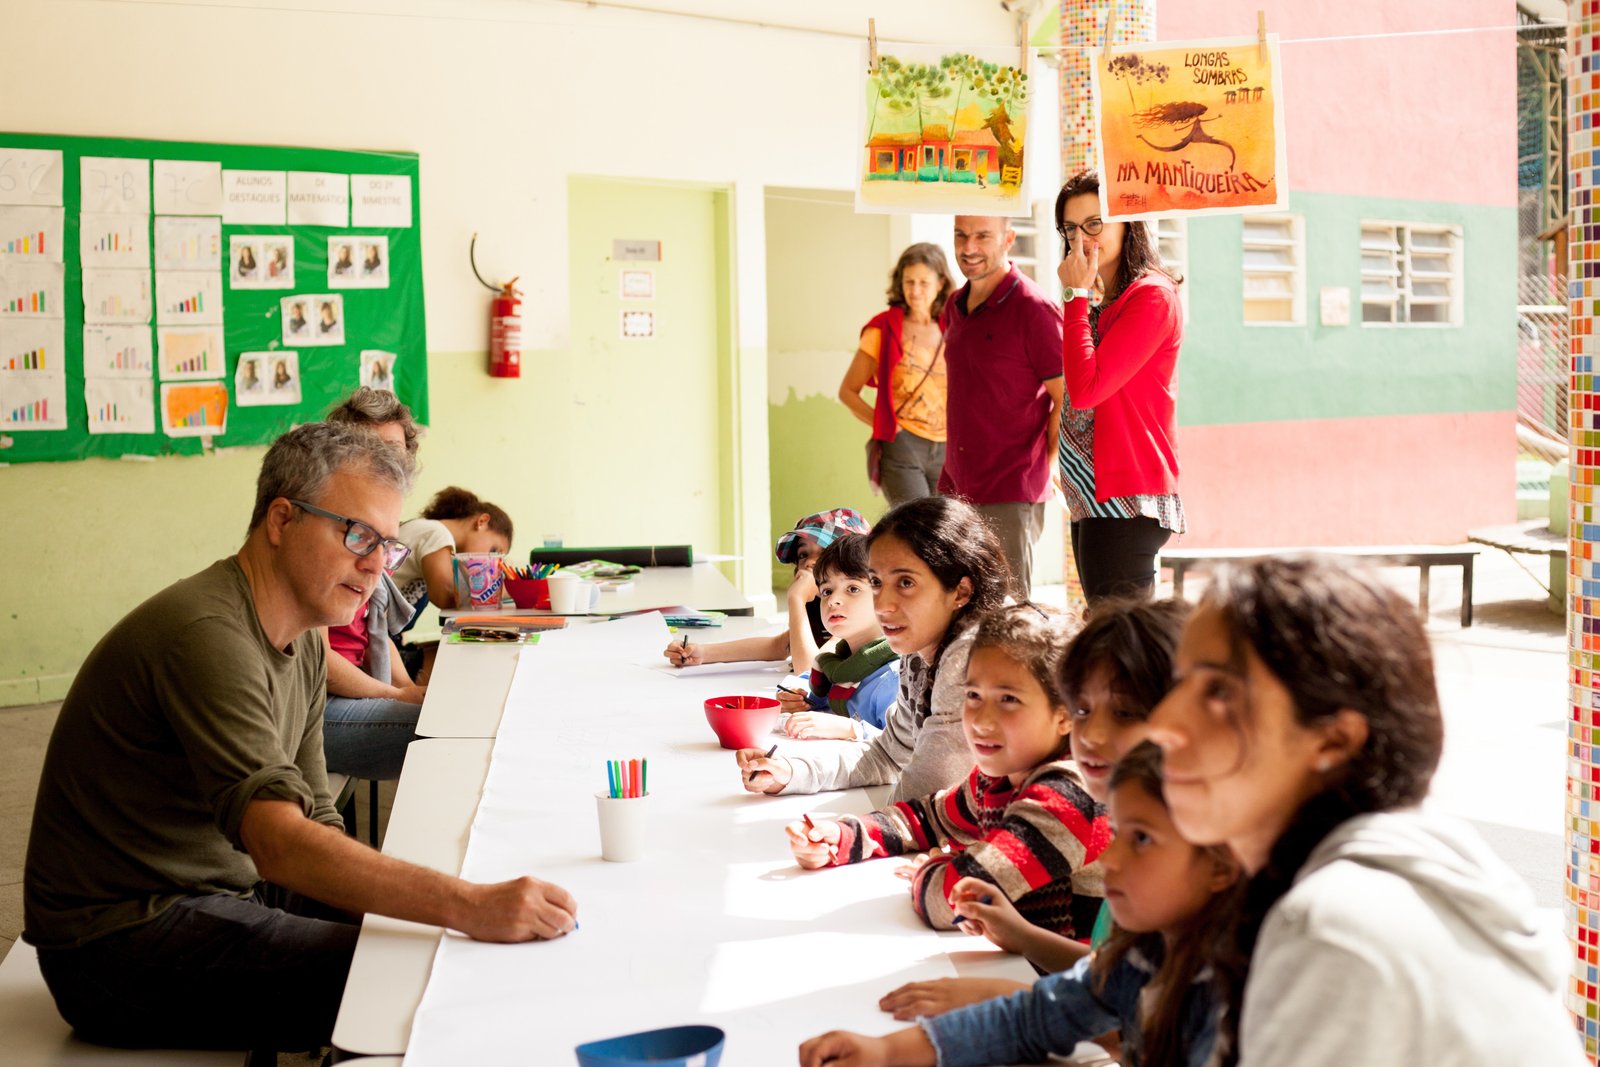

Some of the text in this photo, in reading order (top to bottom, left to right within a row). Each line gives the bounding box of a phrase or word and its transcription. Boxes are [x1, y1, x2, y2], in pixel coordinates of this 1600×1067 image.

[1184, 52, 1230, 68] LONGAS
[1193, 68, 1248, 85] SOMBRAS
[1117, 161, 1140, 182] NA
[236, 176, 272, 186] ALUNOS
[229, 193, 280, 203] DESTAQUES
